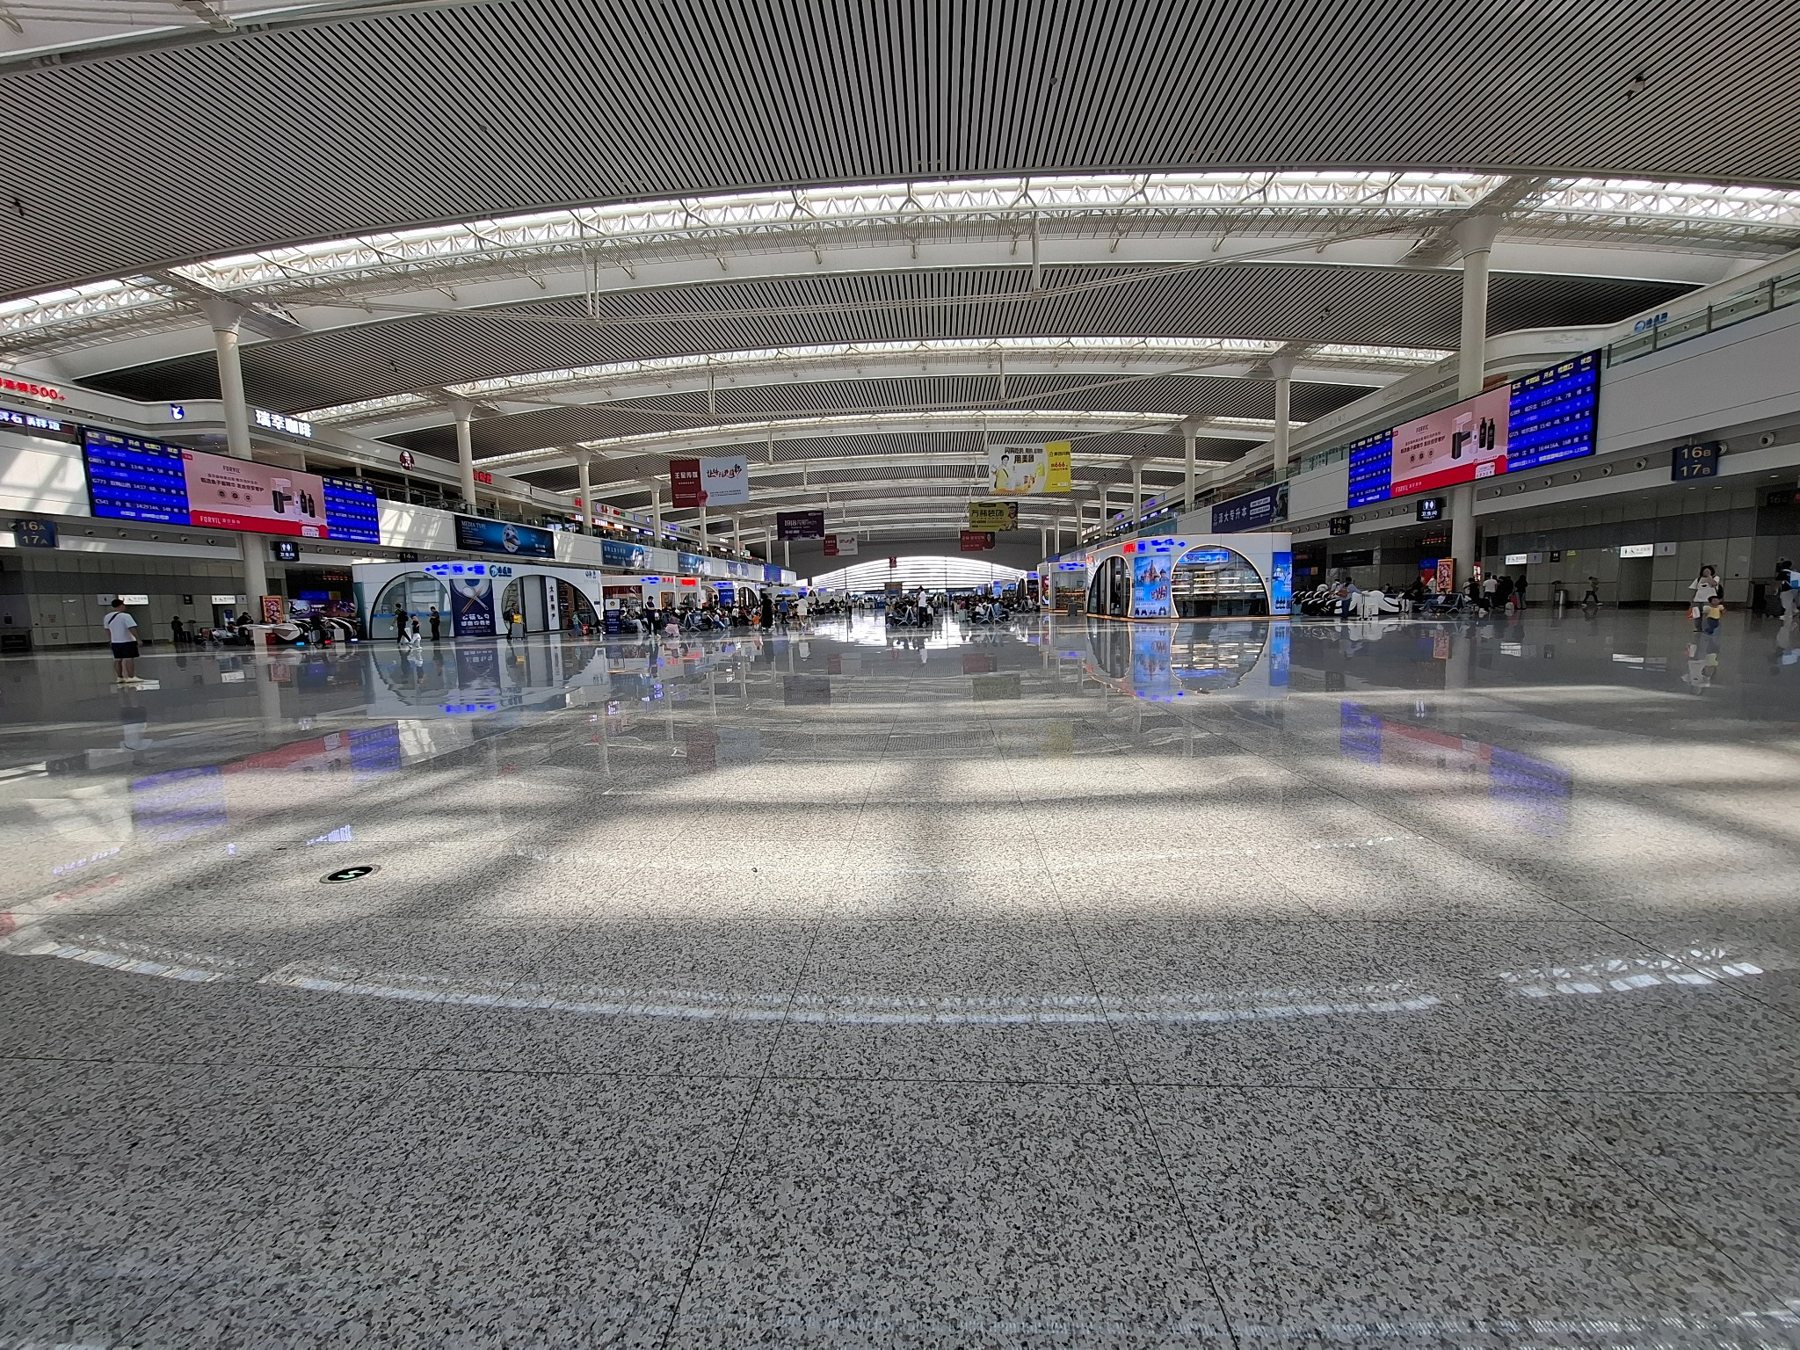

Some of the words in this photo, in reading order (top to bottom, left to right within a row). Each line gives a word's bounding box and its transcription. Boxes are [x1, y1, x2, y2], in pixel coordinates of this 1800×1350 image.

[255, 409, 312, 438] 瑞幸咖啡
[1682, 446, 1712, 460] 16B
[1681, 464, 1711, 477] 17B
[21, 521, 46, 531] 16A
[22, 535, 48, 545] 17A
